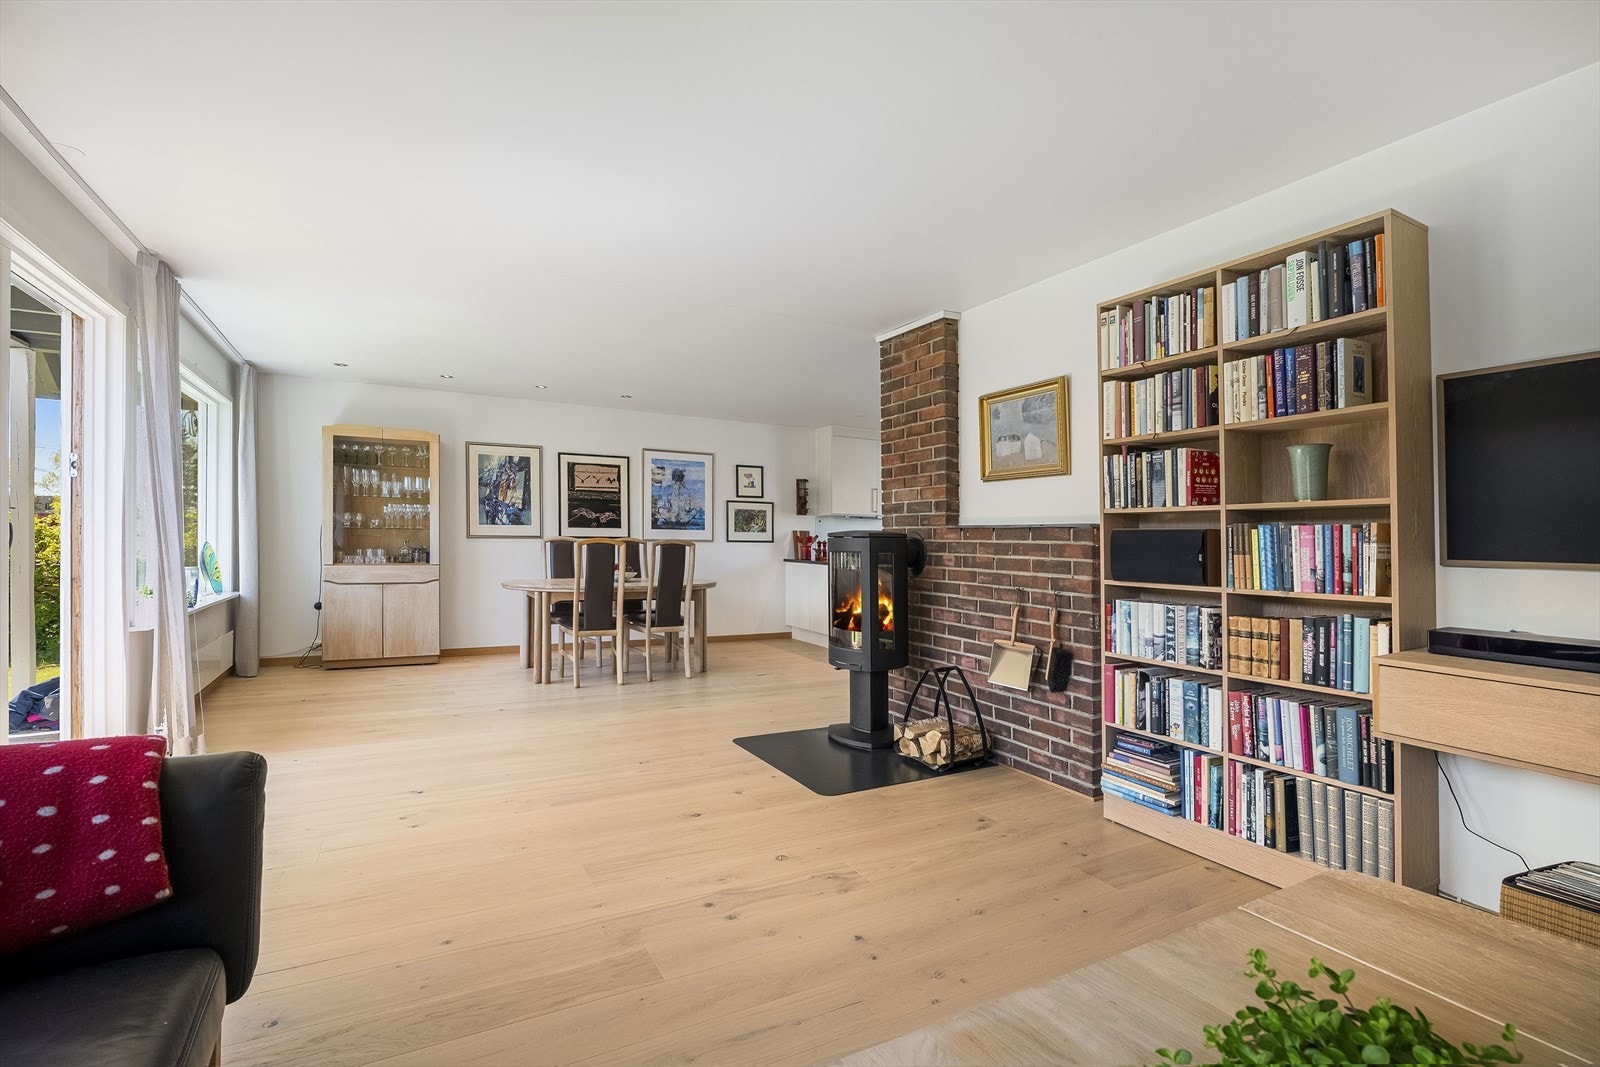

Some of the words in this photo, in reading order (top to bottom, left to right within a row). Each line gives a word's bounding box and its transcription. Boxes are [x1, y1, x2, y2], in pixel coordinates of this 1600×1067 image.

[1295, 258, 1305, 271] JON
[1288, 259, 1296, 303] SEPTOLOGIEN
[1296, 271, 1305, 293] FOSSE
[1344, 716, 1353, 732] JON
[1346, 733, 1354, 771] MICHELET
